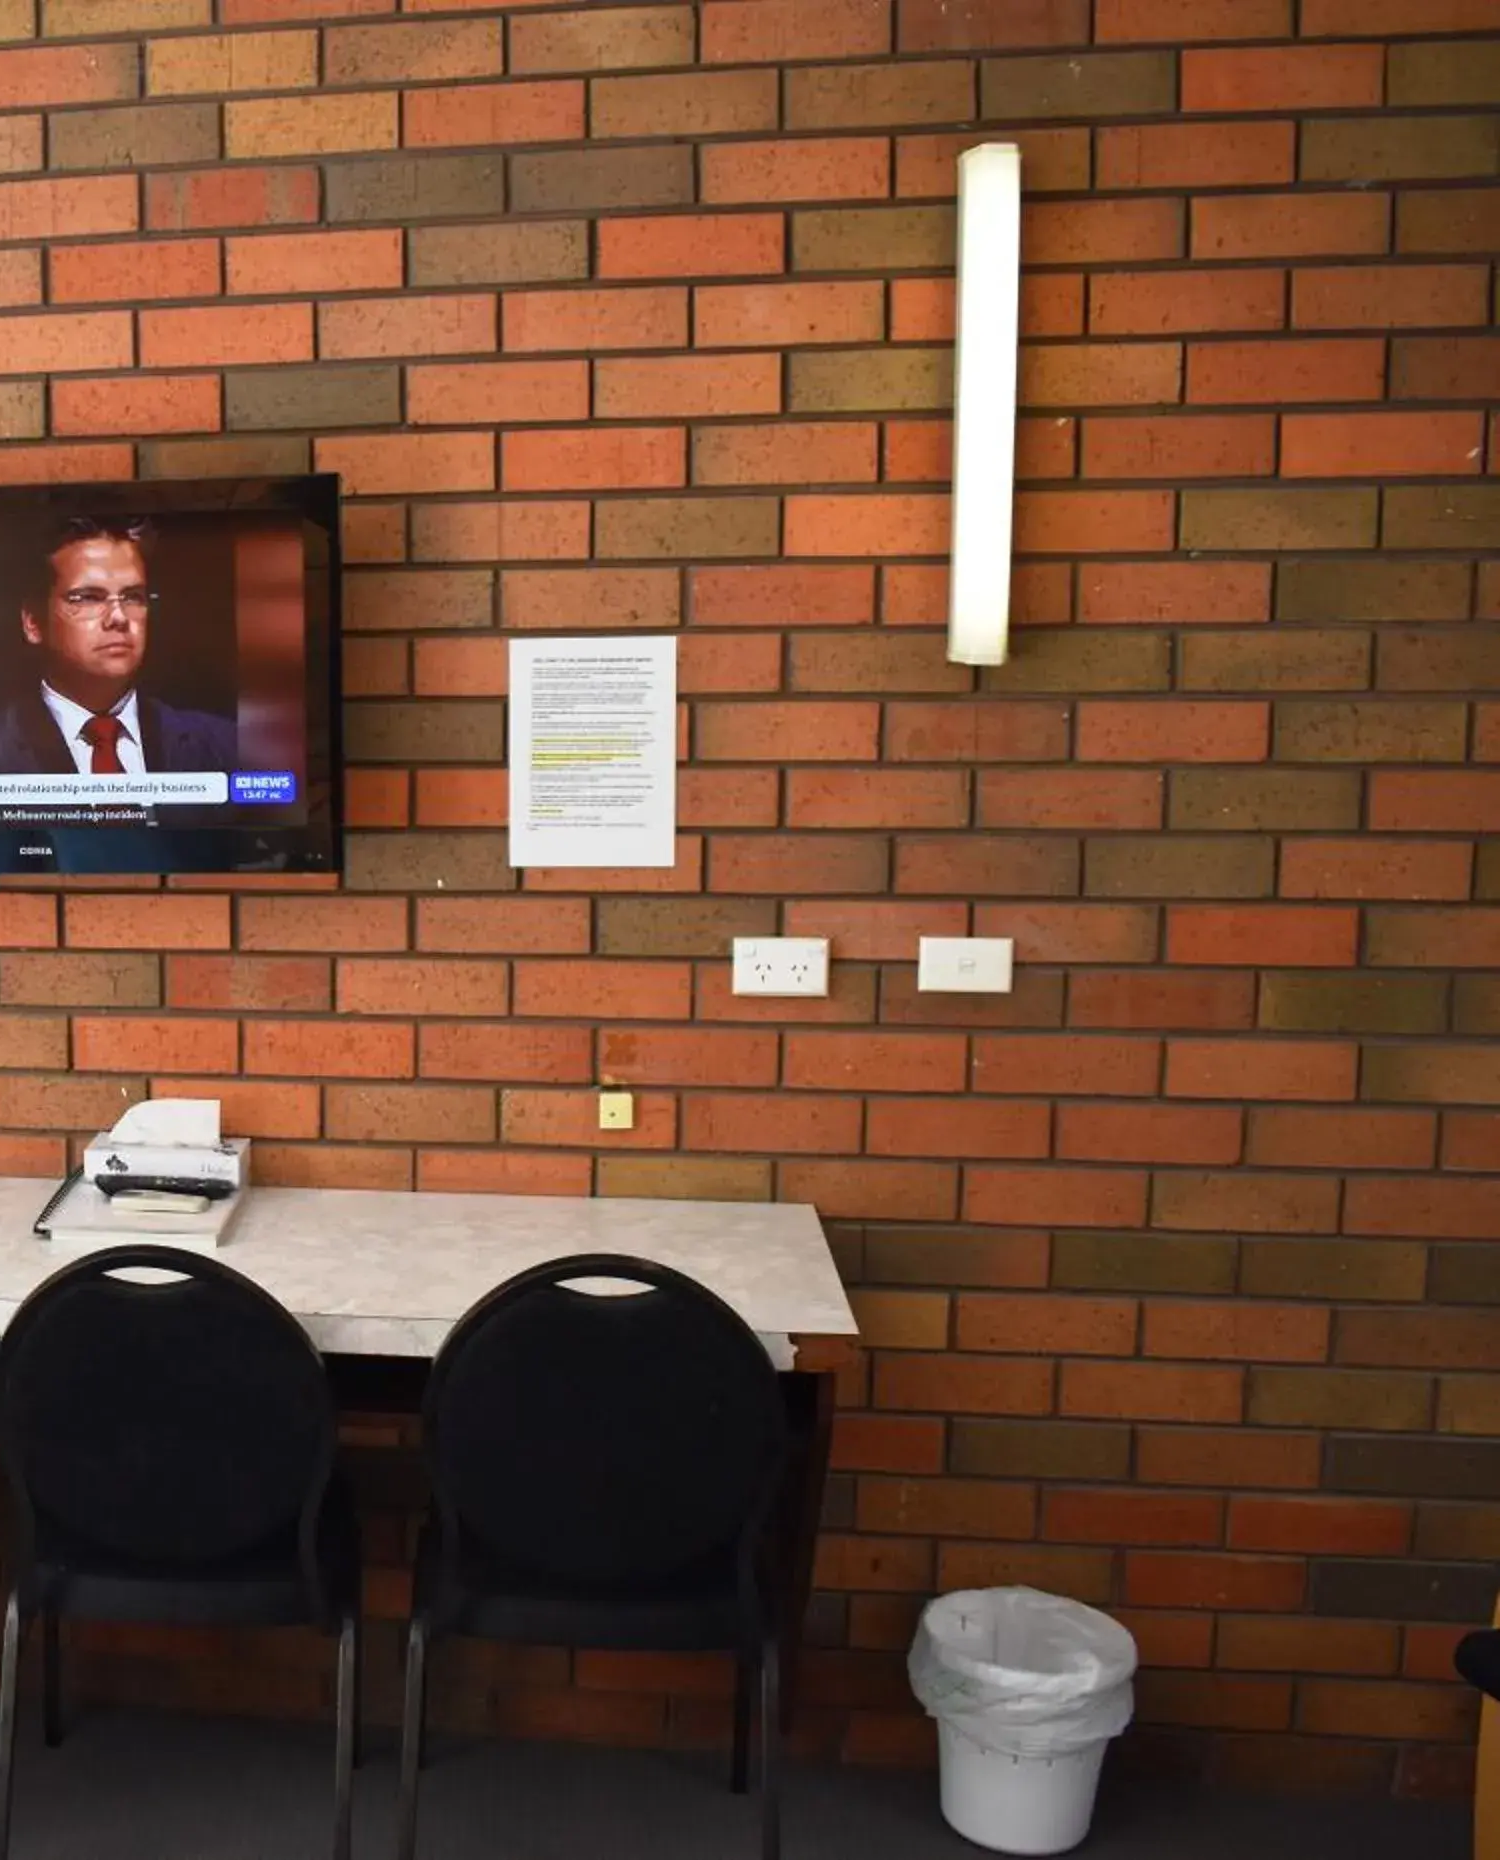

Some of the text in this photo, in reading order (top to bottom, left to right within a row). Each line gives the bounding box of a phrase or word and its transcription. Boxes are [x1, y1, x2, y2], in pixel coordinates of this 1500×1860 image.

[253, 776, 290, 788] NEWS
[18, 783, 80, 795] relationship
[82, 783, 105, 793] with
[107, 783, 125, 792] the
[126, 782, 158, 794] family
[161, 782, 207, 792] business
[3, 810, 56, 821] Melbourne
[58, 811, 80, 821] road
[105, 810, 147, 820] incident
